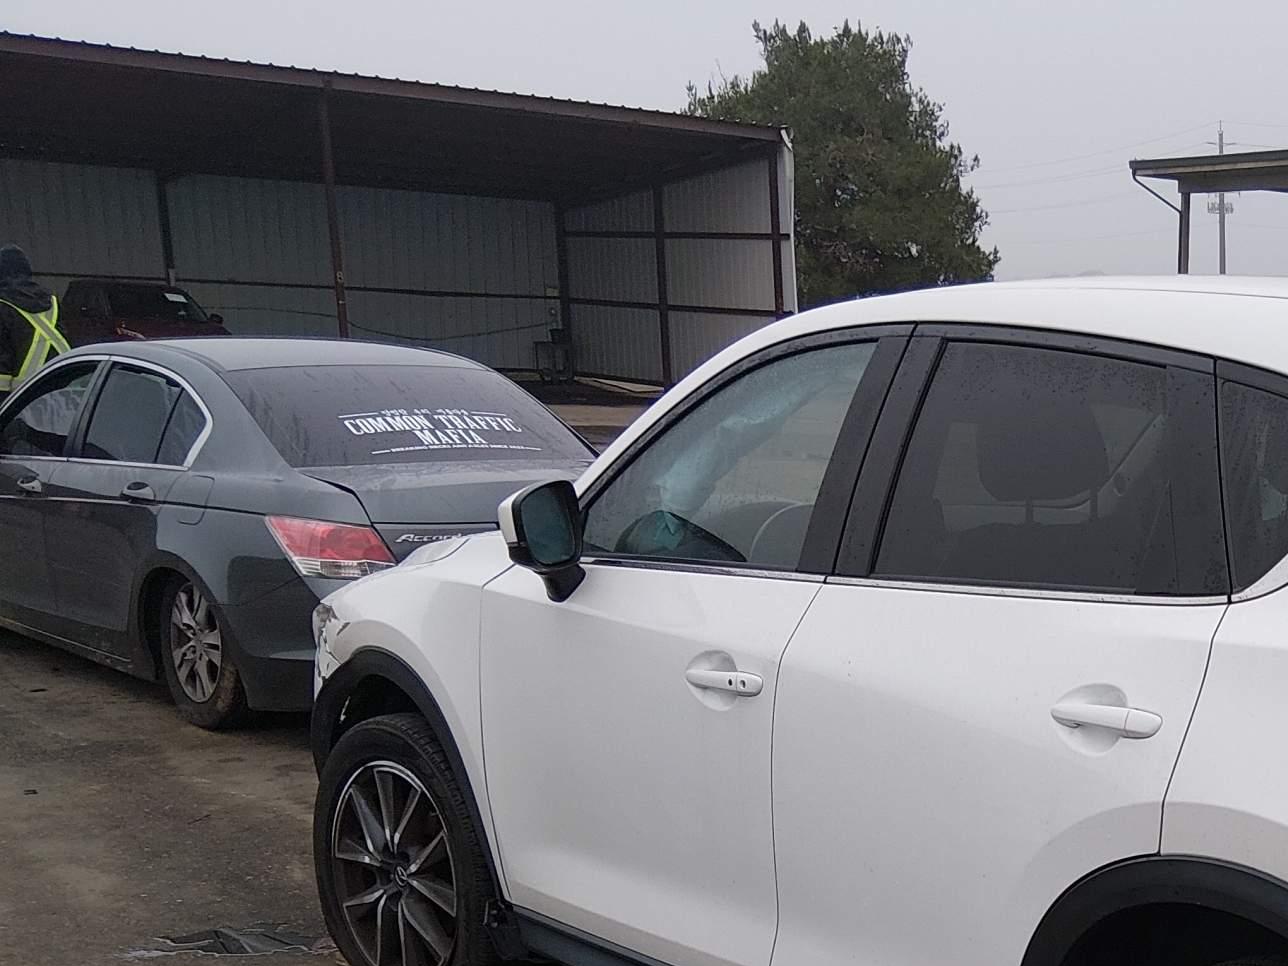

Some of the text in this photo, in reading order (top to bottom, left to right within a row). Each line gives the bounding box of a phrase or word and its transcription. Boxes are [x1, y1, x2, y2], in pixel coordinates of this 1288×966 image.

[343, 414, 522, 435] COMMON TRAFFIC
[412, 429, 488, 445] MAFIA
